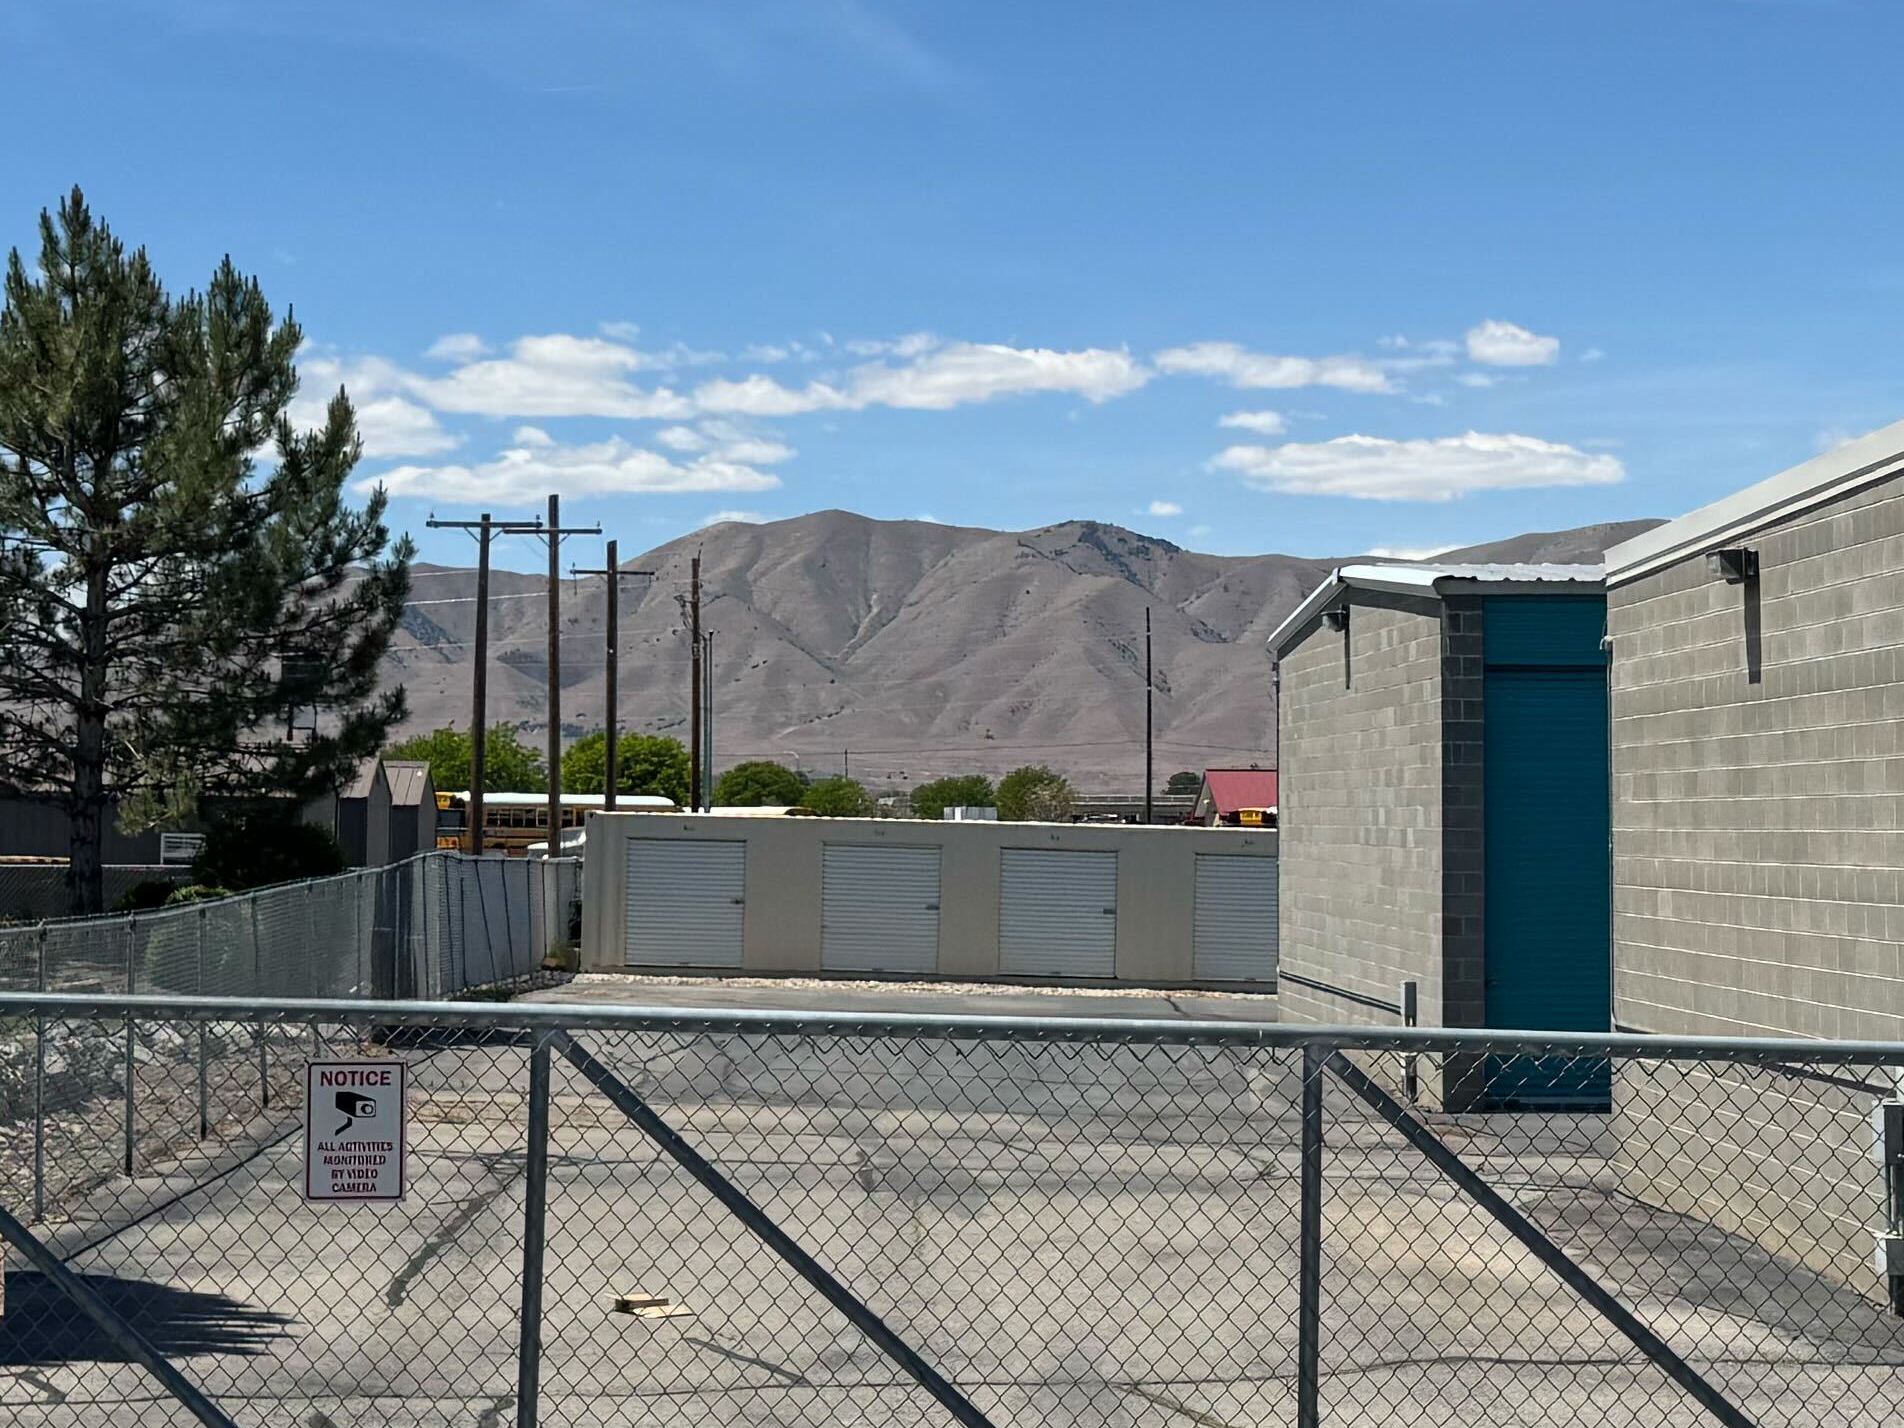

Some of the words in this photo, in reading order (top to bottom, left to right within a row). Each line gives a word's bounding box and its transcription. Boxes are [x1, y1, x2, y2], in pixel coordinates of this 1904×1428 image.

[320, 1070, 392, 1086] NOTICE
[317, 1141, 336, 1152] ALL
[337, 1141, 393, 1152] ACTIVITIES
[332, 1182, 377, 1193] CAMERA
